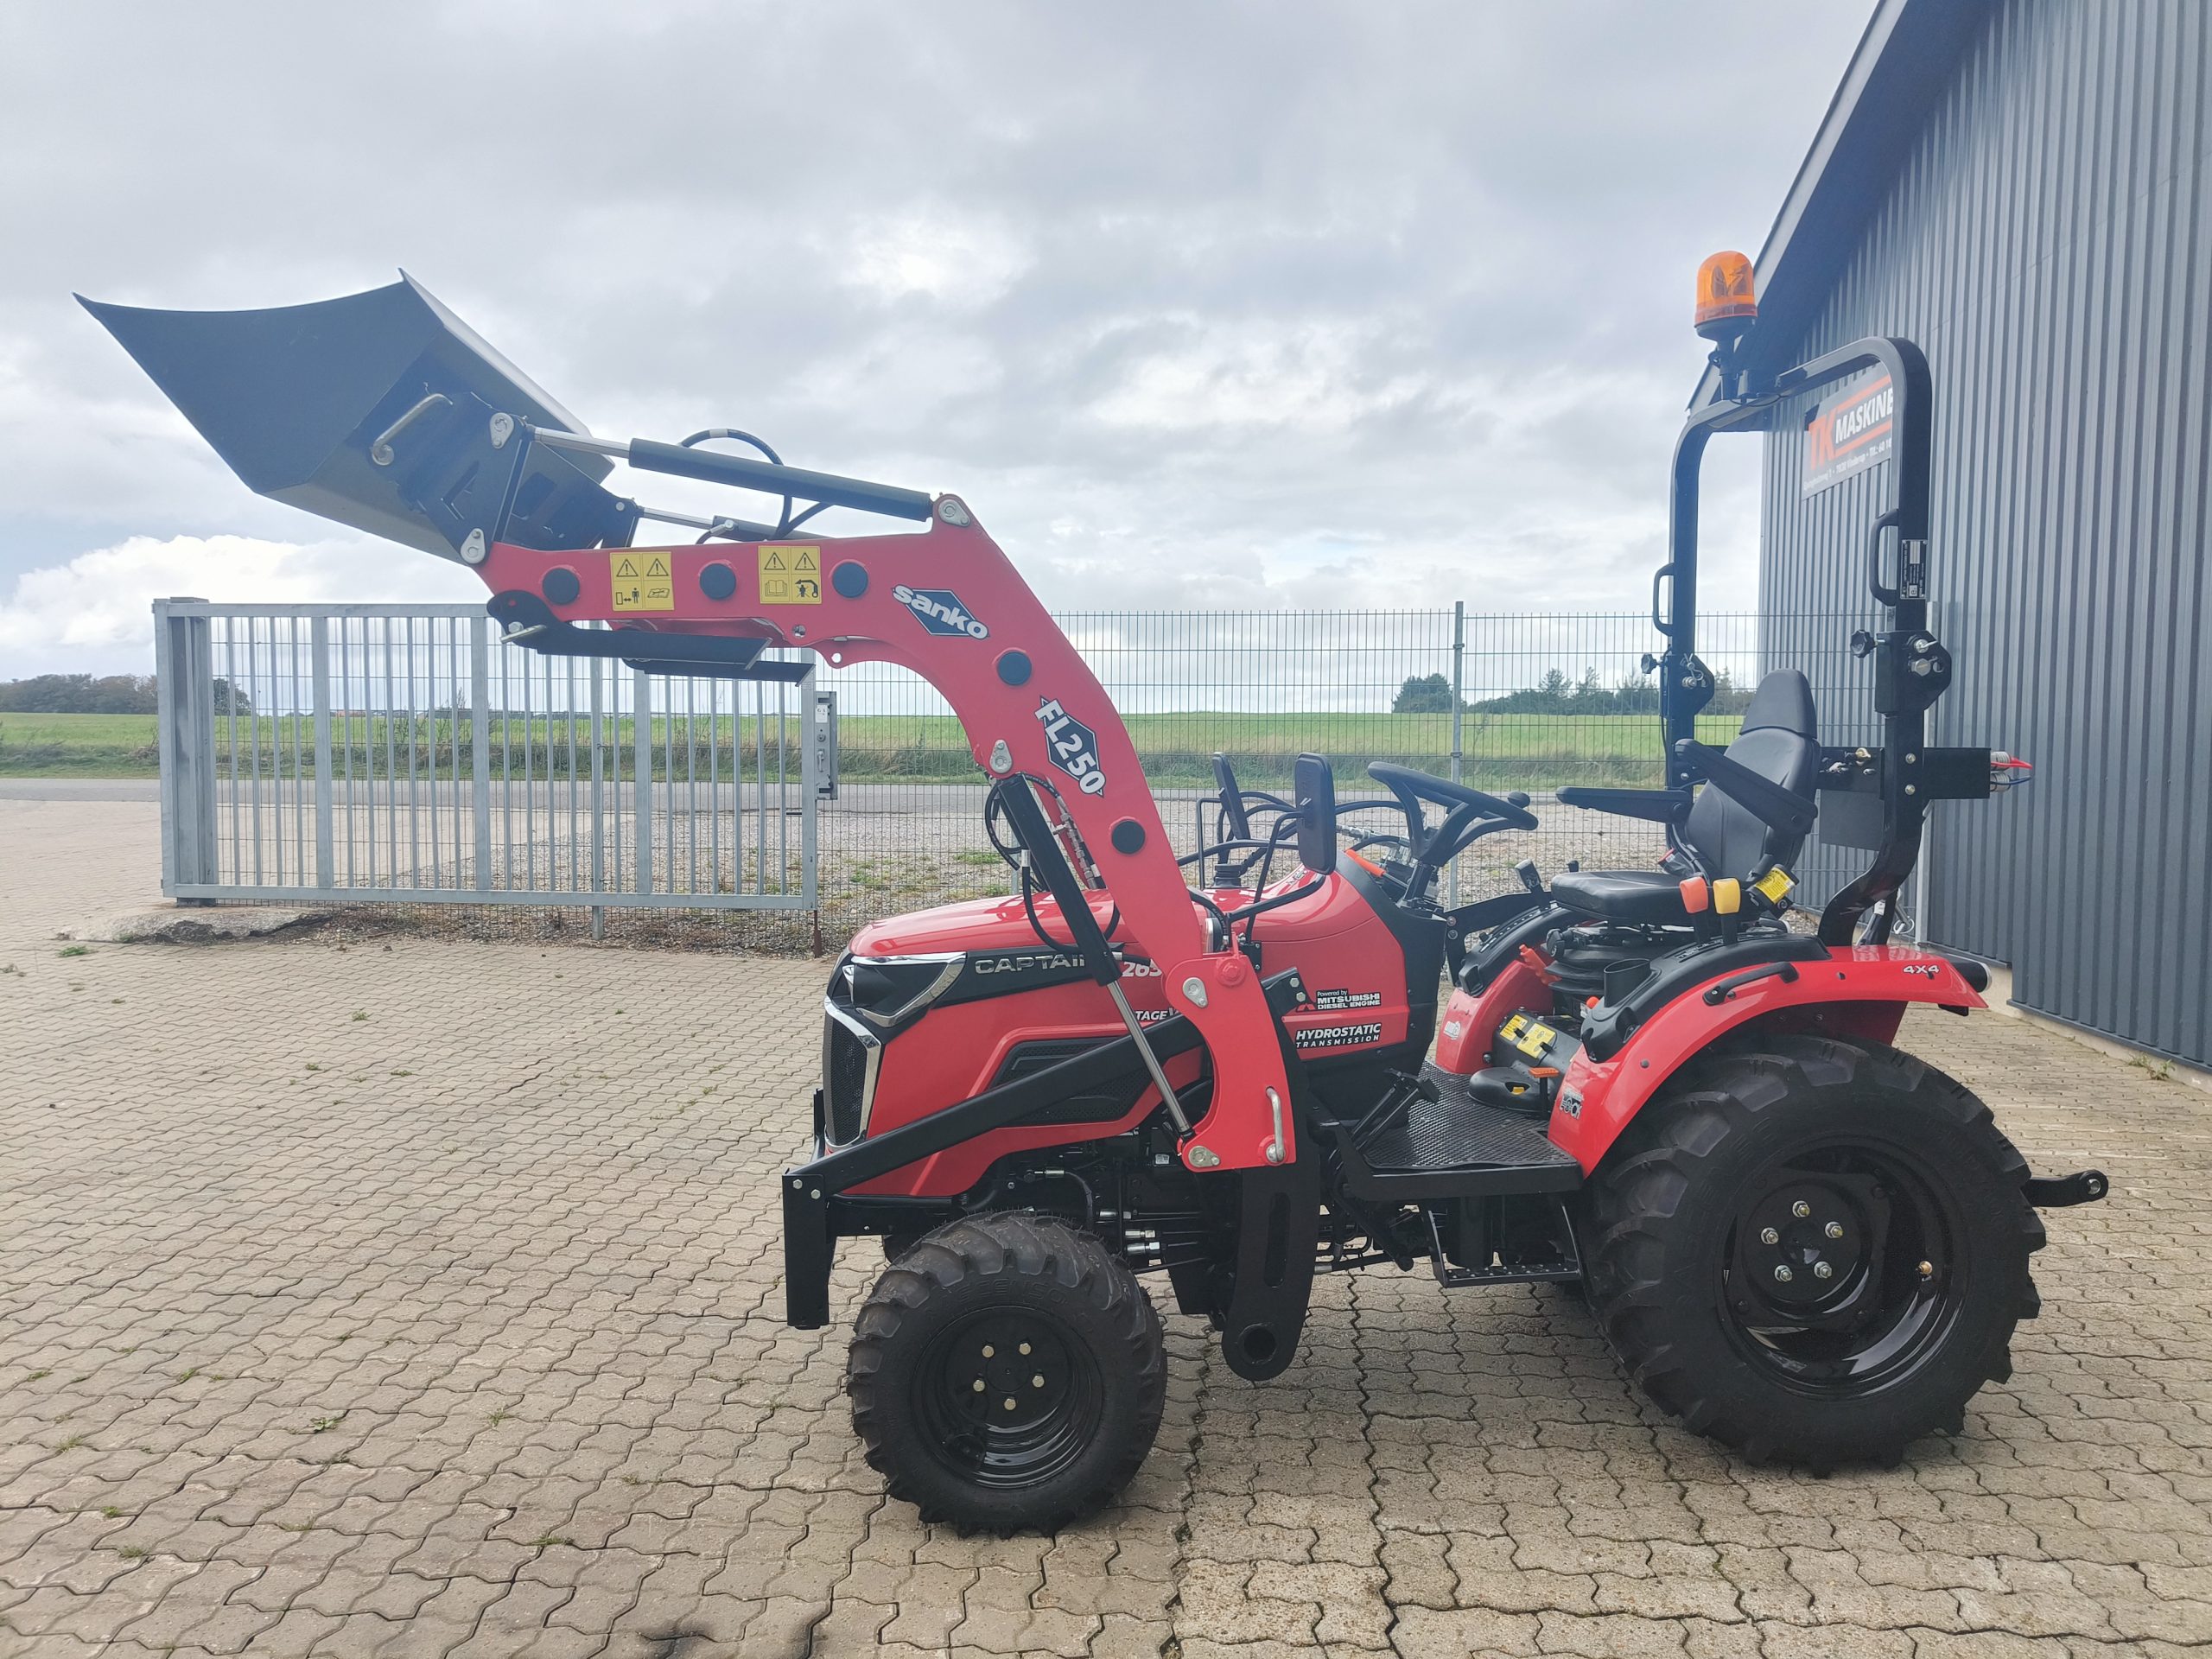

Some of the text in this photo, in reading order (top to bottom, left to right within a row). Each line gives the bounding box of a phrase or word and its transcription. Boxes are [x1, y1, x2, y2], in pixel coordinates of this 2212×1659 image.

[1808, 387, 1893, 470] TK MASKINE
[893, 586, 988, 639] sanko
[1034, 699, 1105, 794] FL250
[1317, 993, 1380, 1004] MITSUBISHI
[1135, 1010, 1168, 1020] TAGE
[1296, 1023, 1382, 1040] HYDROSTATIC
[1296, 1035, 1380, 1048] TRANSMISSION
